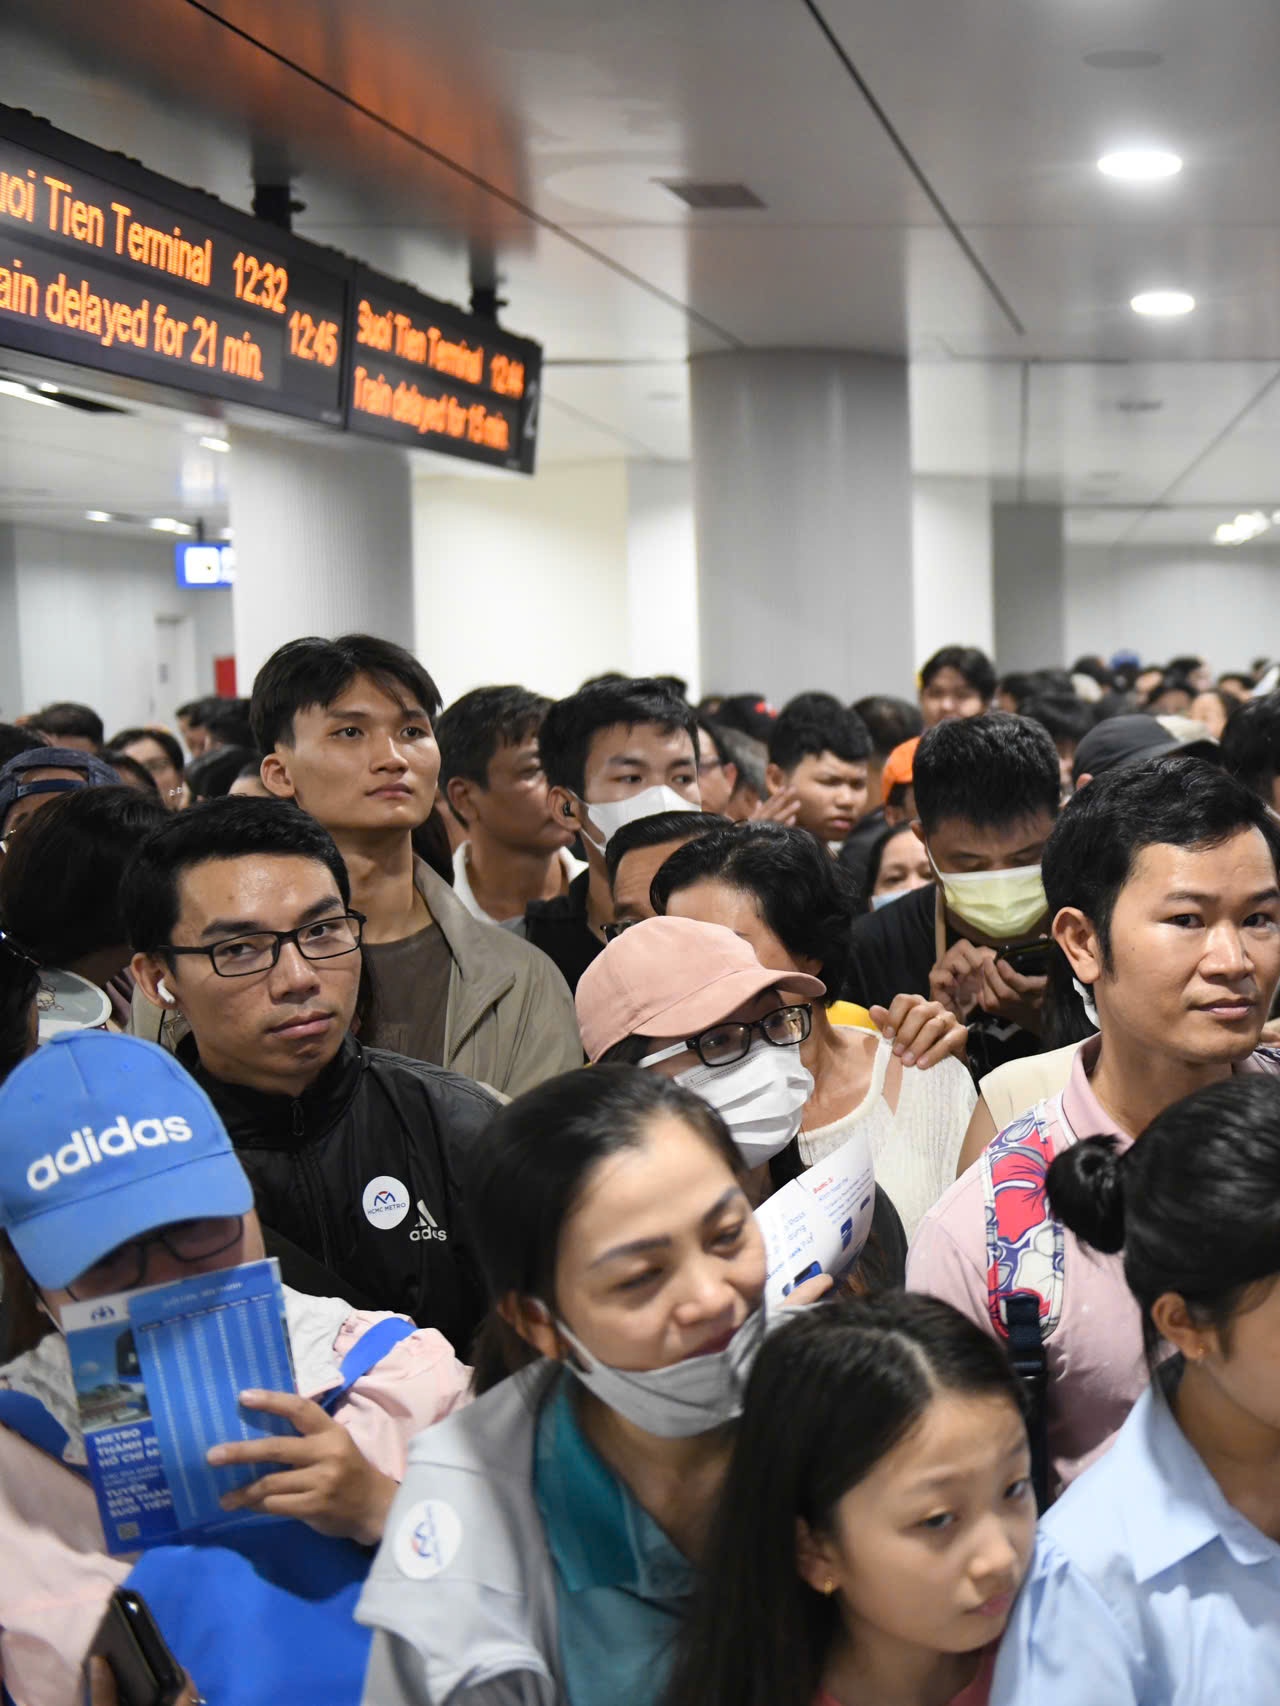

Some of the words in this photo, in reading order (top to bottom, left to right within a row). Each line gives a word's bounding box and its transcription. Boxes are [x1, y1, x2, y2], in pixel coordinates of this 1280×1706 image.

[43, 175, 105, 248] Tien
[111, 202, 213, 287] Terminal
[232, 252, 289, 314] 12:32
[45, 273, 150, 348] delayed
[153, 304, 189, 358] for
[190, 315, 218, 368] 21
[289, 311, 339, 367] 12:45
[393, 313, 428, 364] Tien
[427, 326, 483, 384] Terminal
[354, 366, 393, 418] Train
[392, 381, 448, 434] delayed
[447, 396, 469, 438] for
[27, 1115, 192, 1191] adidas
[367, 1206, 384, 1216] HCMC
[384, 1202, 406, 1212] METRO
